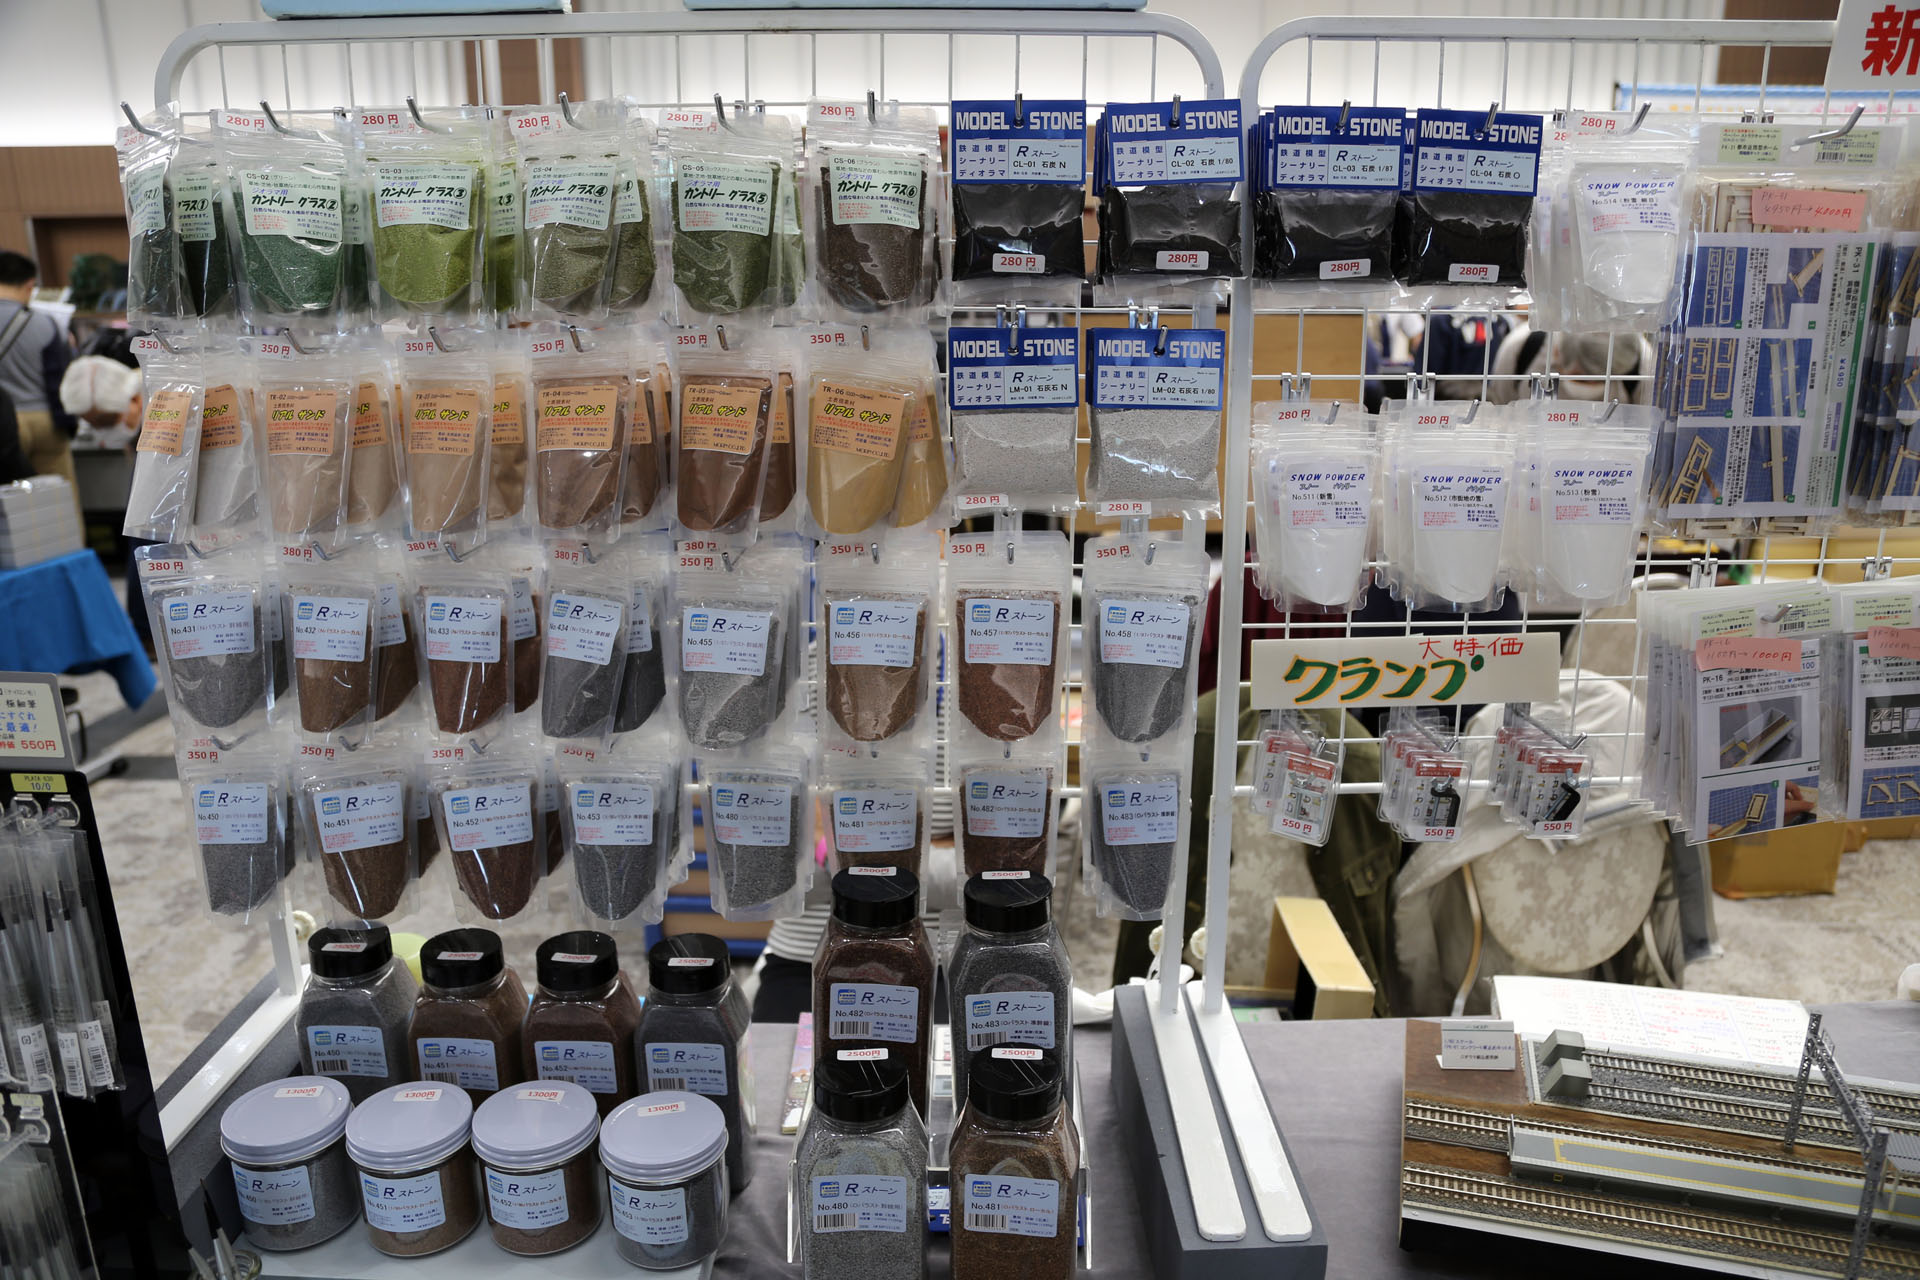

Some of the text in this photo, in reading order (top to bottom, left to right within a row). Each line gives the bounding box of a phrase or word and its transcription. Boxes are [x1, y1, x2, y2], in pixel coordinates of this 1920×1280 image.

[956, 112, 1082, 130] MODEL STONE
[1112, 111, 1238, 133] MODEL STONE
[1581, 117, 1615, 129] 280円
[1278, 117, 1402, 136] MODEL STONE
[1420, 120, 1539, 144] MODEL STONE
[959, 144, 1006, 152] 鉄道模型
[1116, 146, 1163, 155] 鉄道模型
[1280, 149, 1326, 157] 鉄道模型
[1421, 152, 1465, 162] 鉄道模型
[838, 181, 877, 192] カントリー
[1587, 181, 1675, 190] SNOW POWDER
[380, 187, 422, 198] カントリー
[530, 187, 564, 198] カントリー
[685, 188, 725, 199] カントリー
[251, 195, 294, 206] カントリー
[1000, 257, 1036, 266] 280円
[1168, 254, 1198, 263] 280円
[1330, 262, 1360, 272] 280円
[1459, 267, 1489, 276] 280円
[677, 335, 707, 345] 350円
[810, 333, 845, 344] 350円
[261, 343, 290, 355] 350円
[405, 342, 434, 352] 350円
[532, 340, 564, 352] 350円
[953, 339, 1075, 358] MODEL STONE
[1099, 340, 1221, 359] MODEL STONE
[957, 371, 1001, 379] 鉄道模型
[1101, 370, 1146, 378] 鉄道模型
[823, 386, 844, 394] TR-06
[1278, 409, 1310, 420] 280円
[1547, 412, 1579, 423] 280円
[1418, 415, 1449, 425] 280円
[1290, 473, 1365, 482] SNOW POWDER
[1554, 469, 1633, 478] SNOW POWDER
[1423, 476, 1501, 485] SNOW POWDER
[966, 495, 1000, 505] 280円
[1108, 502, 1142, 512] 280円
[283, 546, 312, 558] 380円
[952, 543, 985, 553] 350円
[1096, 545, 1130, 558] 350円
[555, 551, 579, 561] 380円
[148, 561, 183, 571] 380円
[681, 557, 713, 567] 350円
[835, 631, 860, 639] No.456
[970, 629, 998, 637] No.457
[1105, 629, 1132, 638] No.458
[688, 638, 712, 646] No.455
[1418, 637, 1524, 660] 大特価
[1284, 654, 1485, 704] クランプ
[21, 740, 56, 750] 550円
[188, 751, 218, 761] 350円
[301, 746, 335, 757] 350円
[432, 749, 464, 758] 350円
[1282, 818, 1312, 833] 550円
[1543, 822, 1572, 831] 550円
[1425, 828, 1454, 837] 550円
[971, 1020, 999, 1030] No.483
[818, 1202, 848, 1211] No.480
[971, 1202, 1000, 1210] No.481
